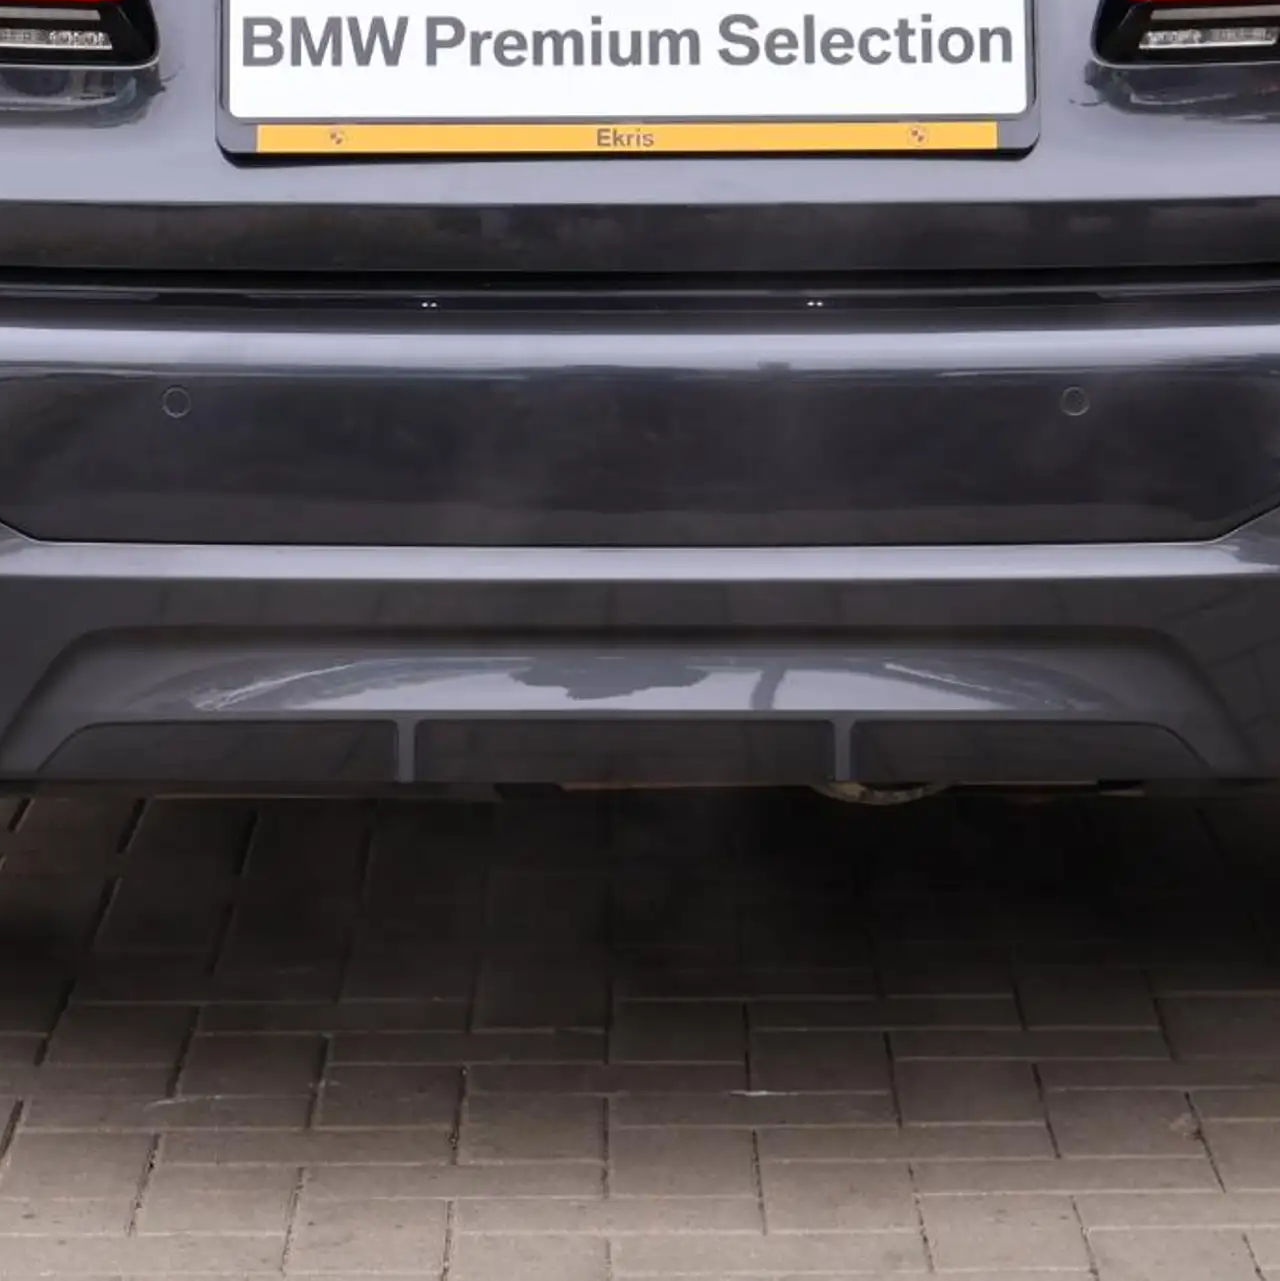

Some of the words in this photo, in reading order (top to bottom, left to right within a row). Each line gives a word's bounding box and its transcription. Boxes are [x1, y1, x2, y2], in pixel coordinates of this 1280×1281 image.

[242, 16, 409, 67] BMW
[425, 15, 701, 67] Premium
[717, 13, 1014, 67] Selection
[596, 127, 655, 148] Ekris
